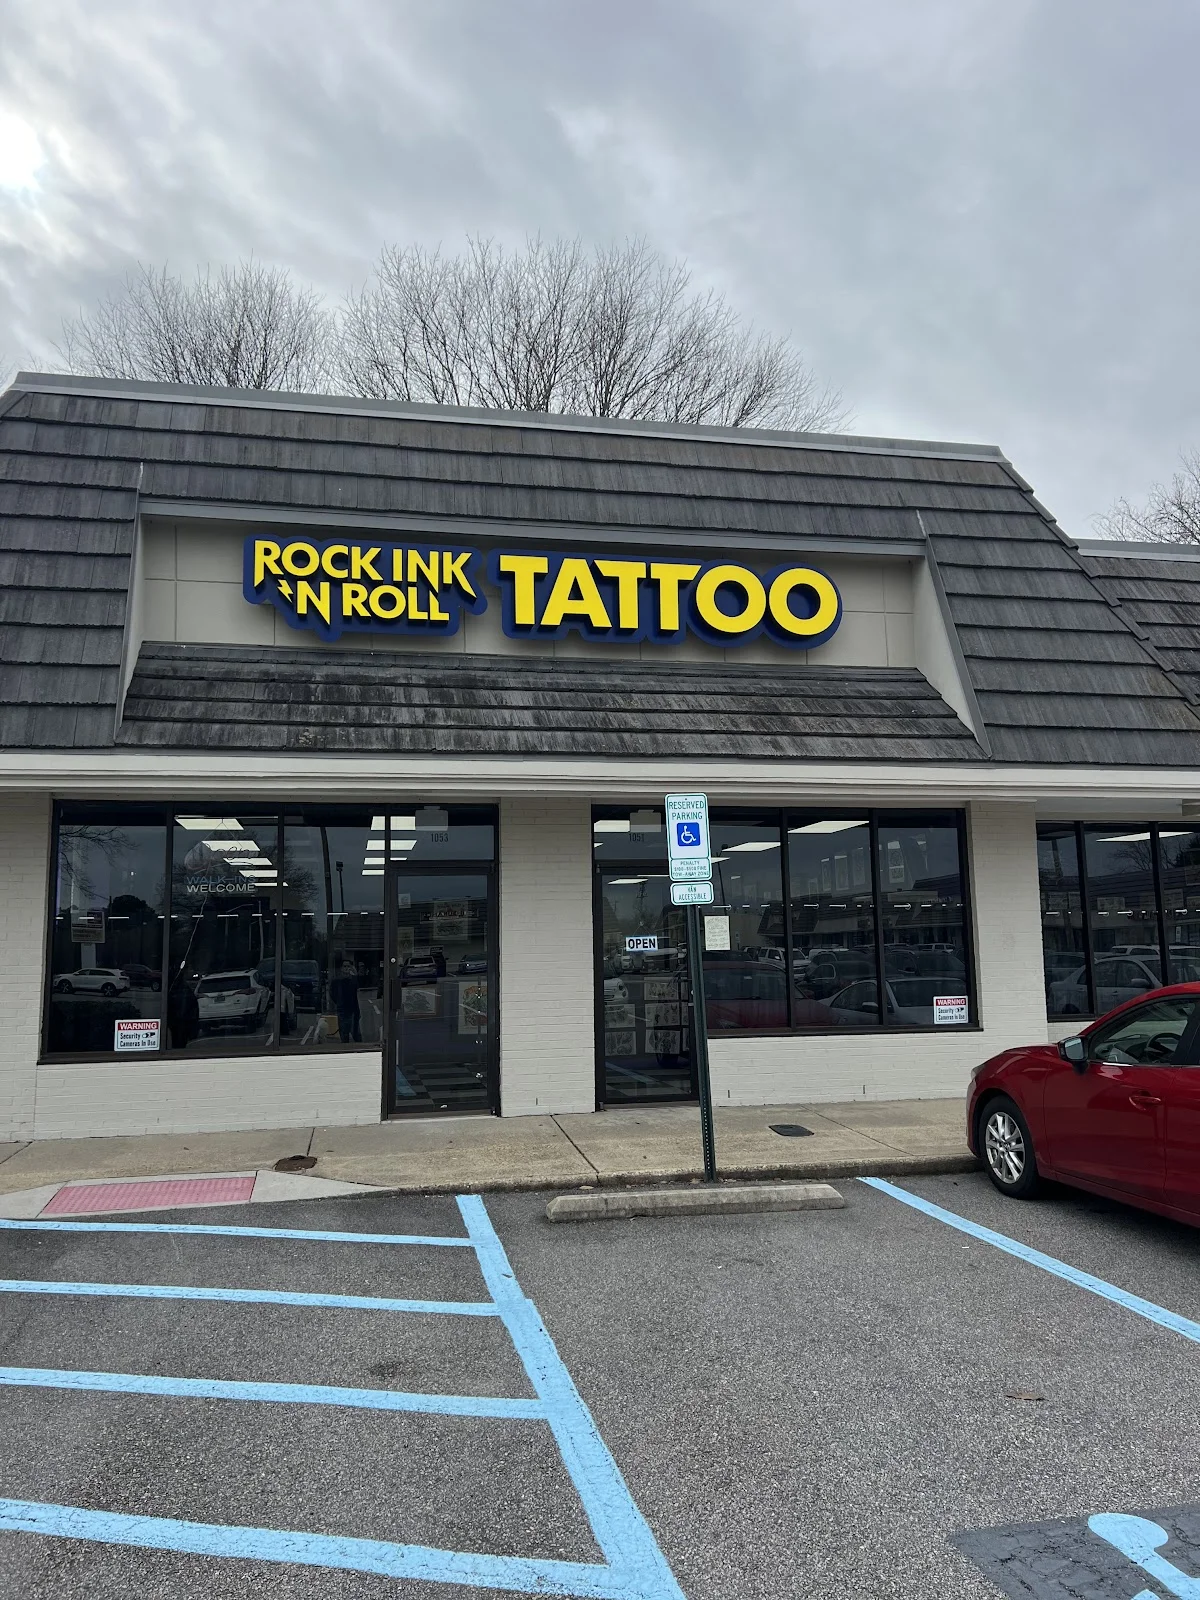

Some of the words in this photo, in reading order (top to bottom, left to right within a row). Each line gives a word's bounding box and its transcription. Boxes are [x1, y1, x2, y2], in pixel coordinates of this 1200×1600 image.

[254, 540, 384, 588] ROCK
[392, 548, 477, 599] INK
[499, 555, 838, 636] TATTOO
[341, 582, 450, 621] ROLL
[669, 801, 704, 809] RESERVED
[672, 812, 702, 820] PARKING
[430, 832, 449, 843] 1053
[186, 875, 257, 885] WALK-INS
[186, 883, 256, 893] WELCOME
[627, 938, 656, 949] OPEN
